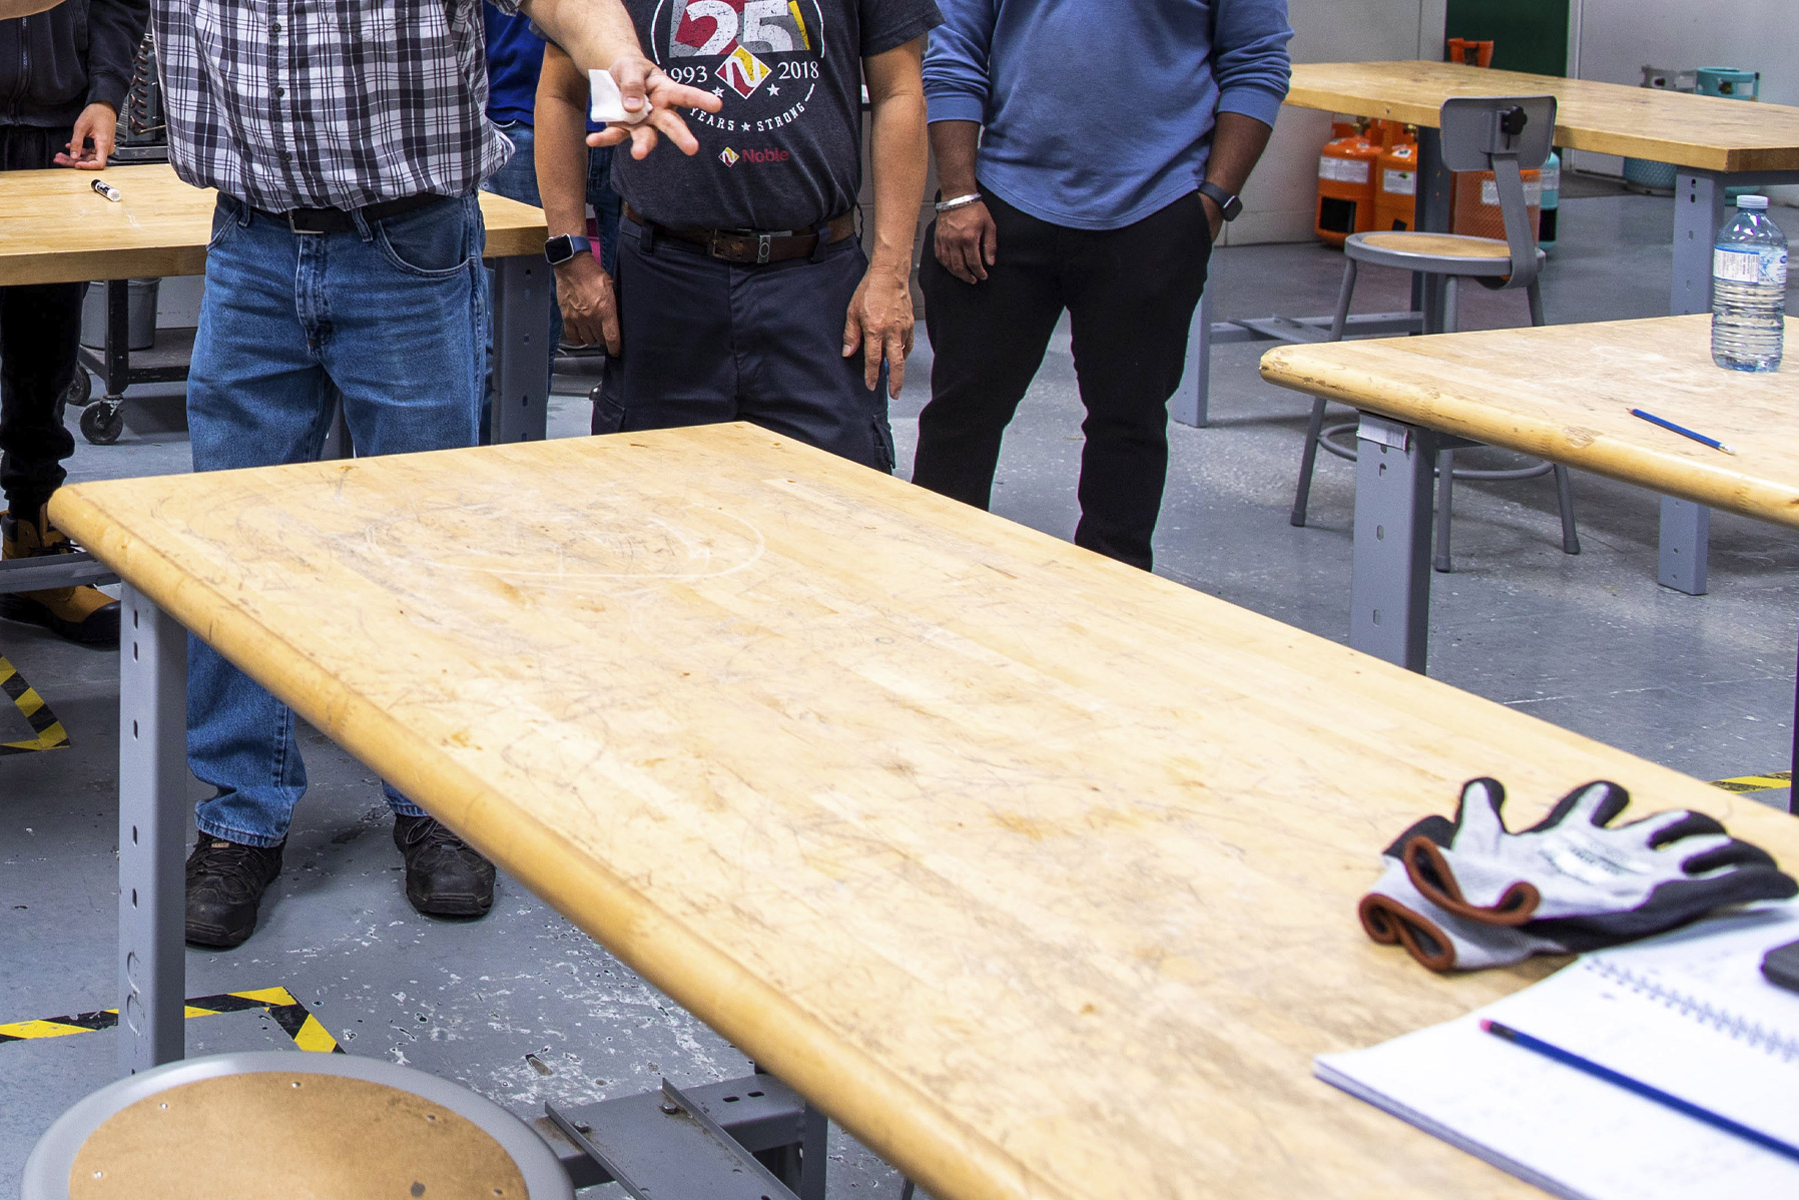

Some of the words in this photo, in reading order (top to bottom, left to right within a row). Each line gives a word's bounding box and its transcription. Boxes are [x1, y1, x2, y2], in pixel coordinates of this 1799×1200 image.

[685, 0, 794, 57] 25
[778, 61, 820, 80] 2018
[689, 107, 735, 132] YEARS
[756, 102, 806, 132] STRONG
[742, 147, 789, 164] Noble
